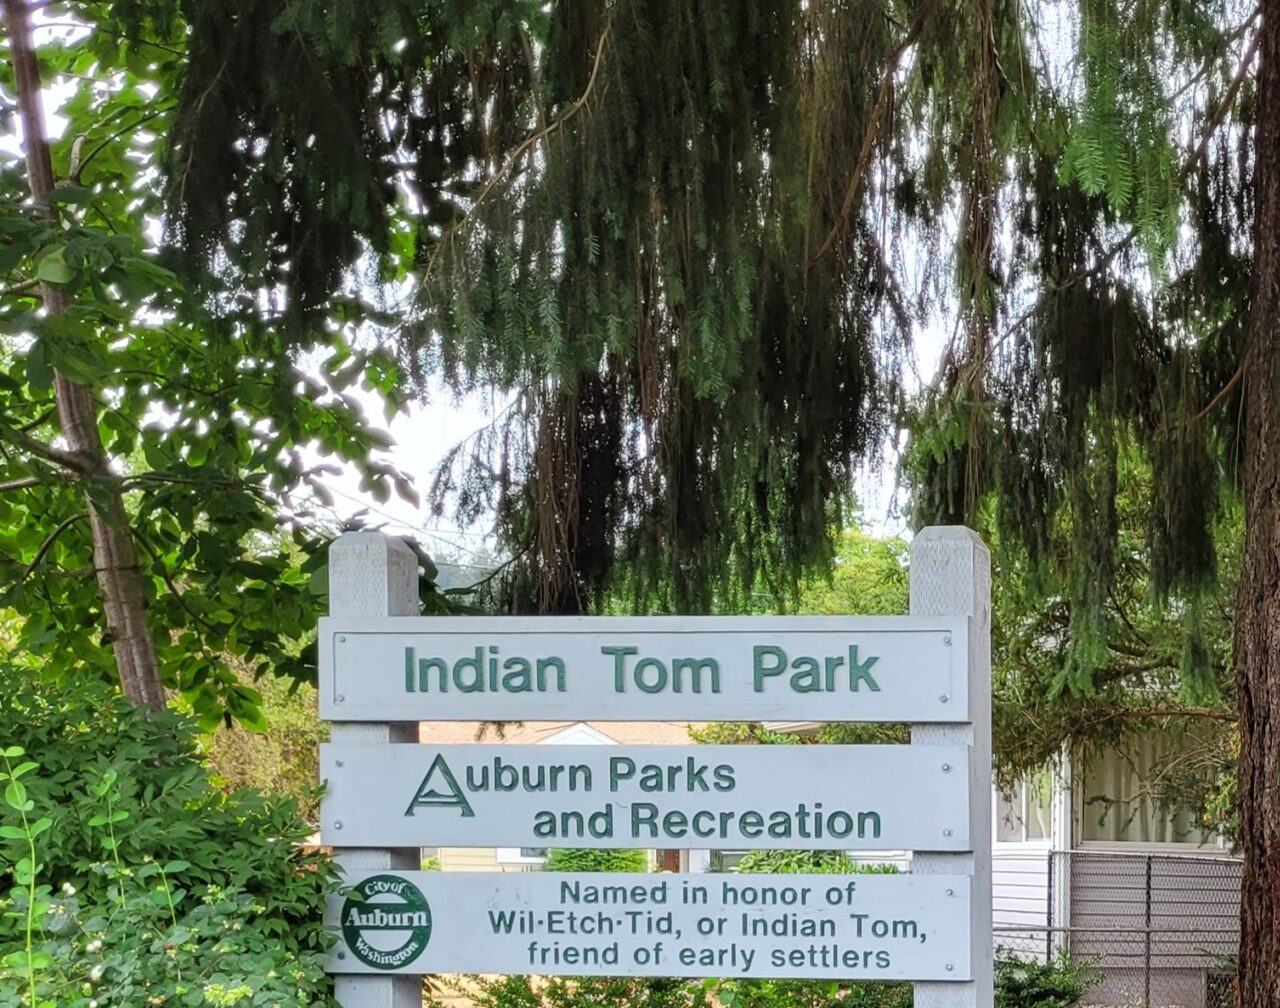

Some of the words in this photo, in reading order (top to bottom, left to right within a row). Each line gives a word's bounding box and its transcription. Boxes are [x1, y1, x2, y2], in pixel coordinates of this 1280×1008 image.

[405, 645, 567, 693] Indian
[601, 645, 720, 694] Tom
[753, 644, 880, 693] Park
[404, 753, 592, 817] Auburn
[610, 756, 736, 792] Parks
[533, 803, 612, 839] and
[631, 802, 881, 839] Recreation
[364, 881, 391, 895] City
[560, 881, 667, 905] Named
[683, 881, 708, 904] in
[722, 882, 811, 905] honor
[825, 881, 856, 905] of
[345, 907, 429, 927] Auburn
[697, 915, 727, 936] or
[742, 912, 836, 937] Indian
[850, 913, 927, 942] Tom,
[355, 936, 419, 966] Washington
[528, 941, 618, 966] friend
[634, 943, 663, 966] of
[679, 943, 755, 971] early
[771, 944, 891, 968] settlers
